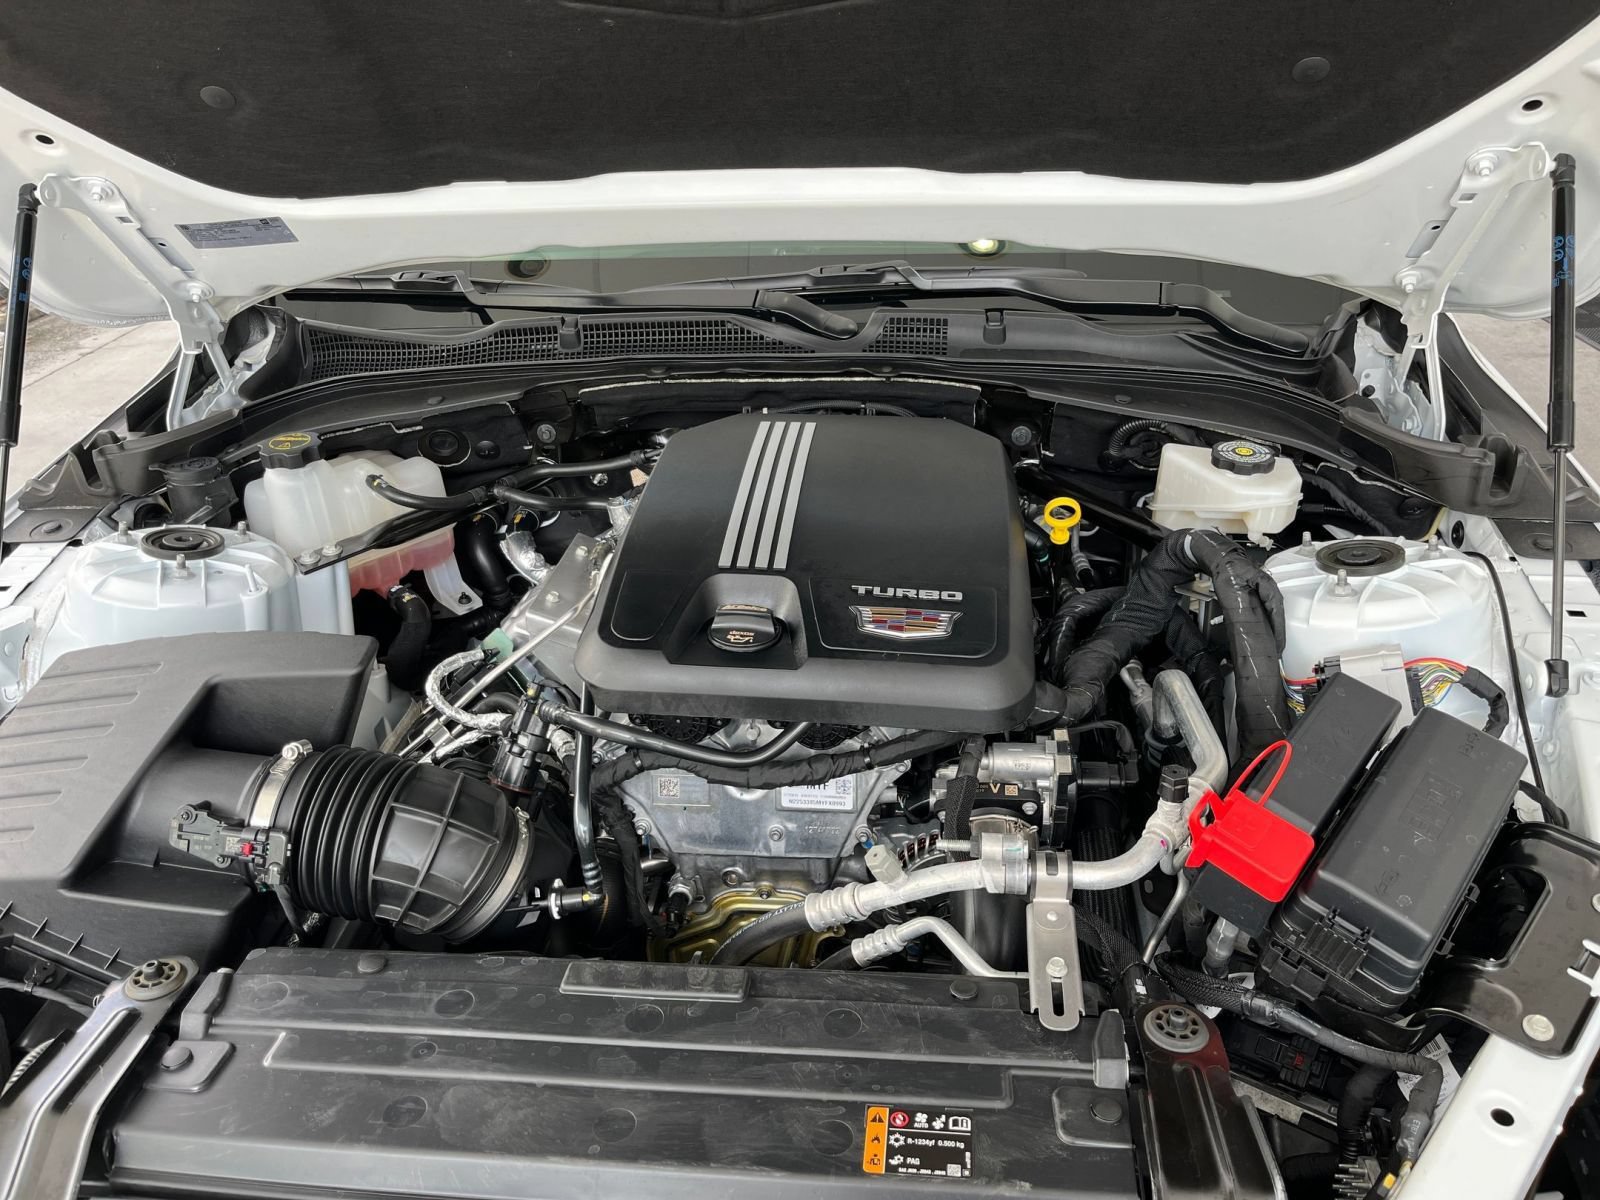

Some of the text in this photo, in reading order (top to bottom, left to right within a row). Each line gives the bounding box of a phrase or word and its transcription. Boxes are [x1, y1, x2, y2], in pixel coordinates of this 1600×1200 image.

[851, 585, 963, 601] TURBO
[989, 783, 1001, 793] V
[907, 1137, 965, 1149] R-1234yf 0.500 kg
[907, 1157, 920, 1165] PAG
